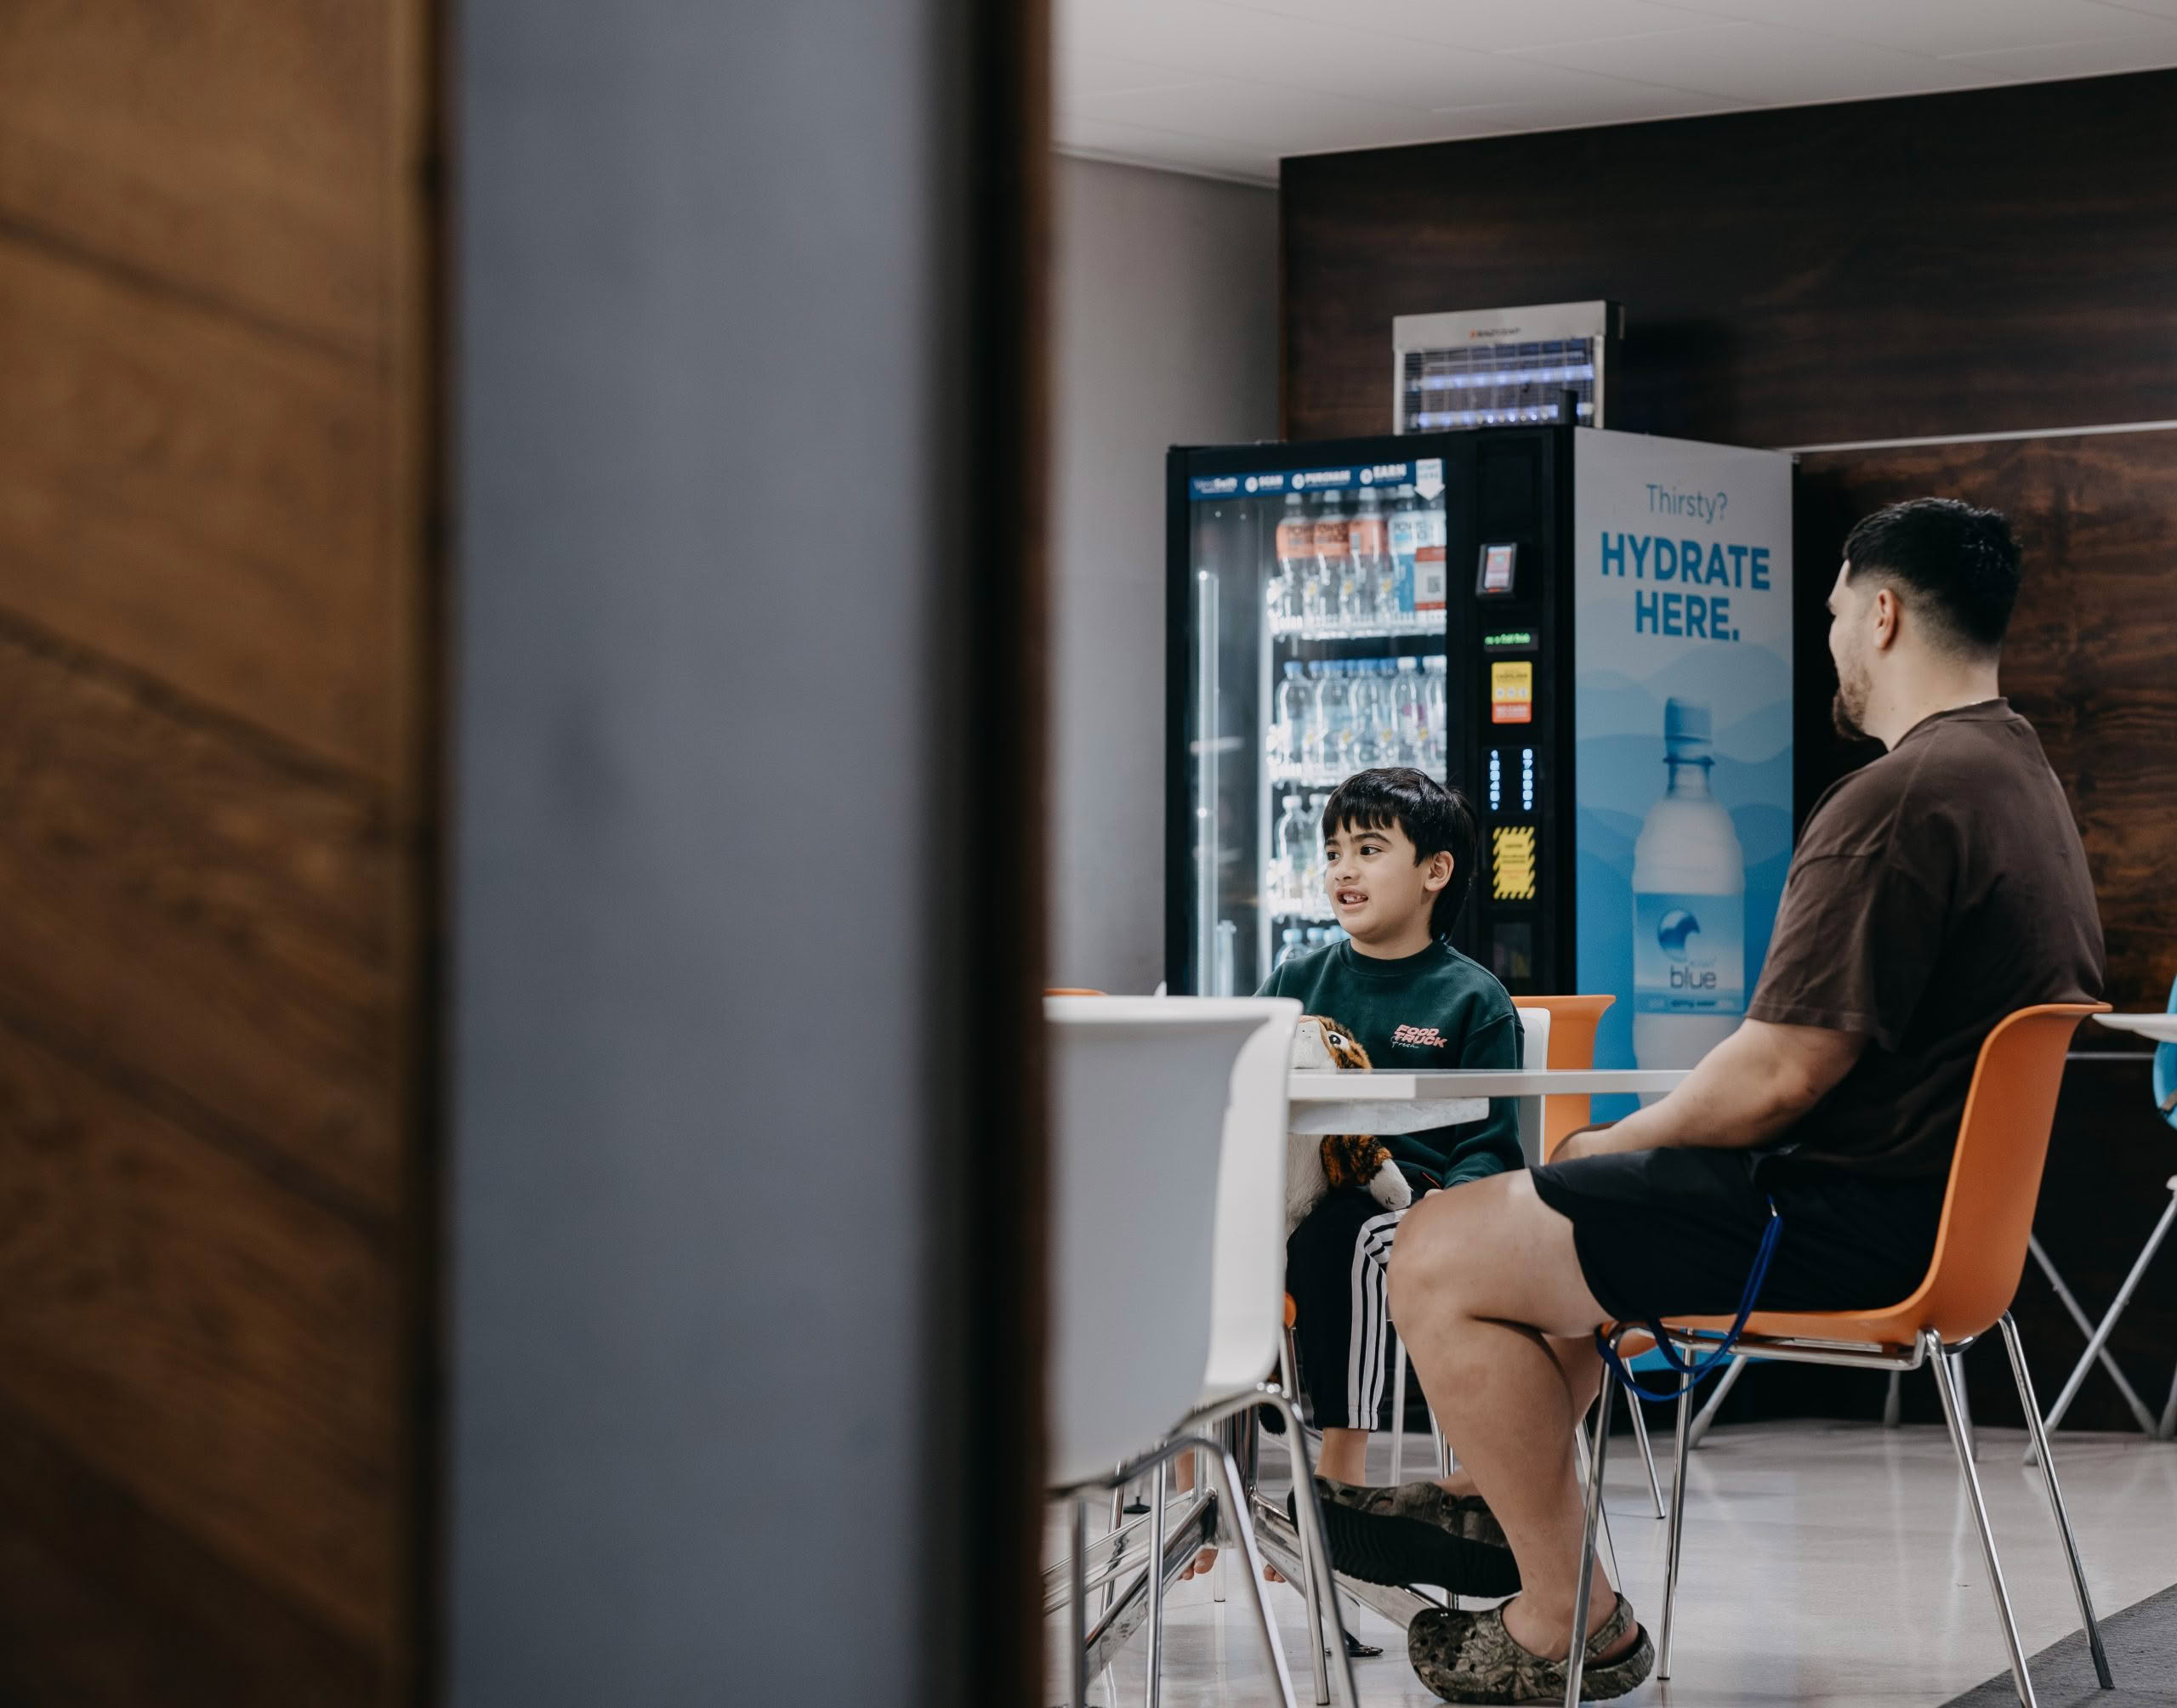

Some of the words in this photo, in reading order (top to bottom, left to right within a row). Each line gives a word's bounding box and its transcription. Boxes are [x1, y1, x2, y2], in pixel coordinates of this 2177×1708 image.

[1646, 484, 1728, 524] Thirsty?
[1601, 531, 1771, 591] HYDRATE
[1635, 590, 1740, 641] HERE.
[1670, 964, 1716, 990] blue
[1395, 1031, 1448, 1048] TRUCK
[1396, 1024, 1440, 1036] FOOD
